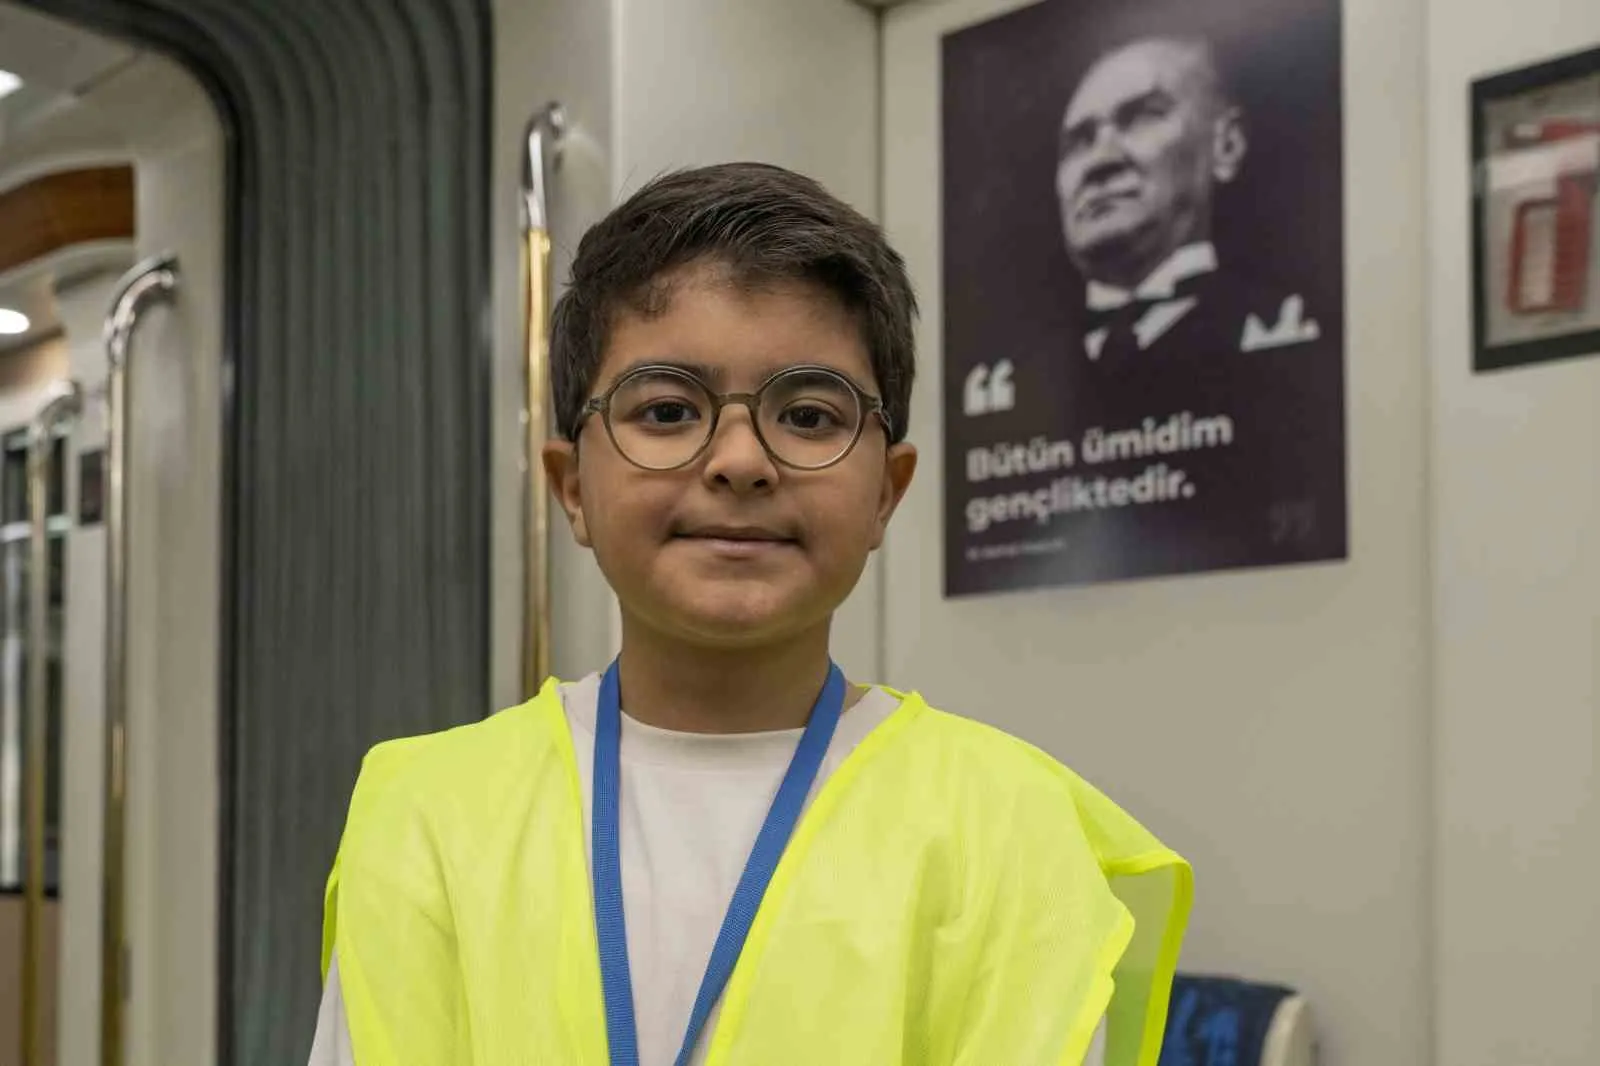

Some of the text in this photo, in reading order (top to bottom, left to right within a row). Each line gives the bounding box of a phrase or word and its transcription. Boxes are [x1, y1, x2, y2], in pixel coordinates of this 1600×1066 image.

[966, 410, 1234, 482] Bütün ümidim
[965, 464, 1196, 532] gençliktedir.
